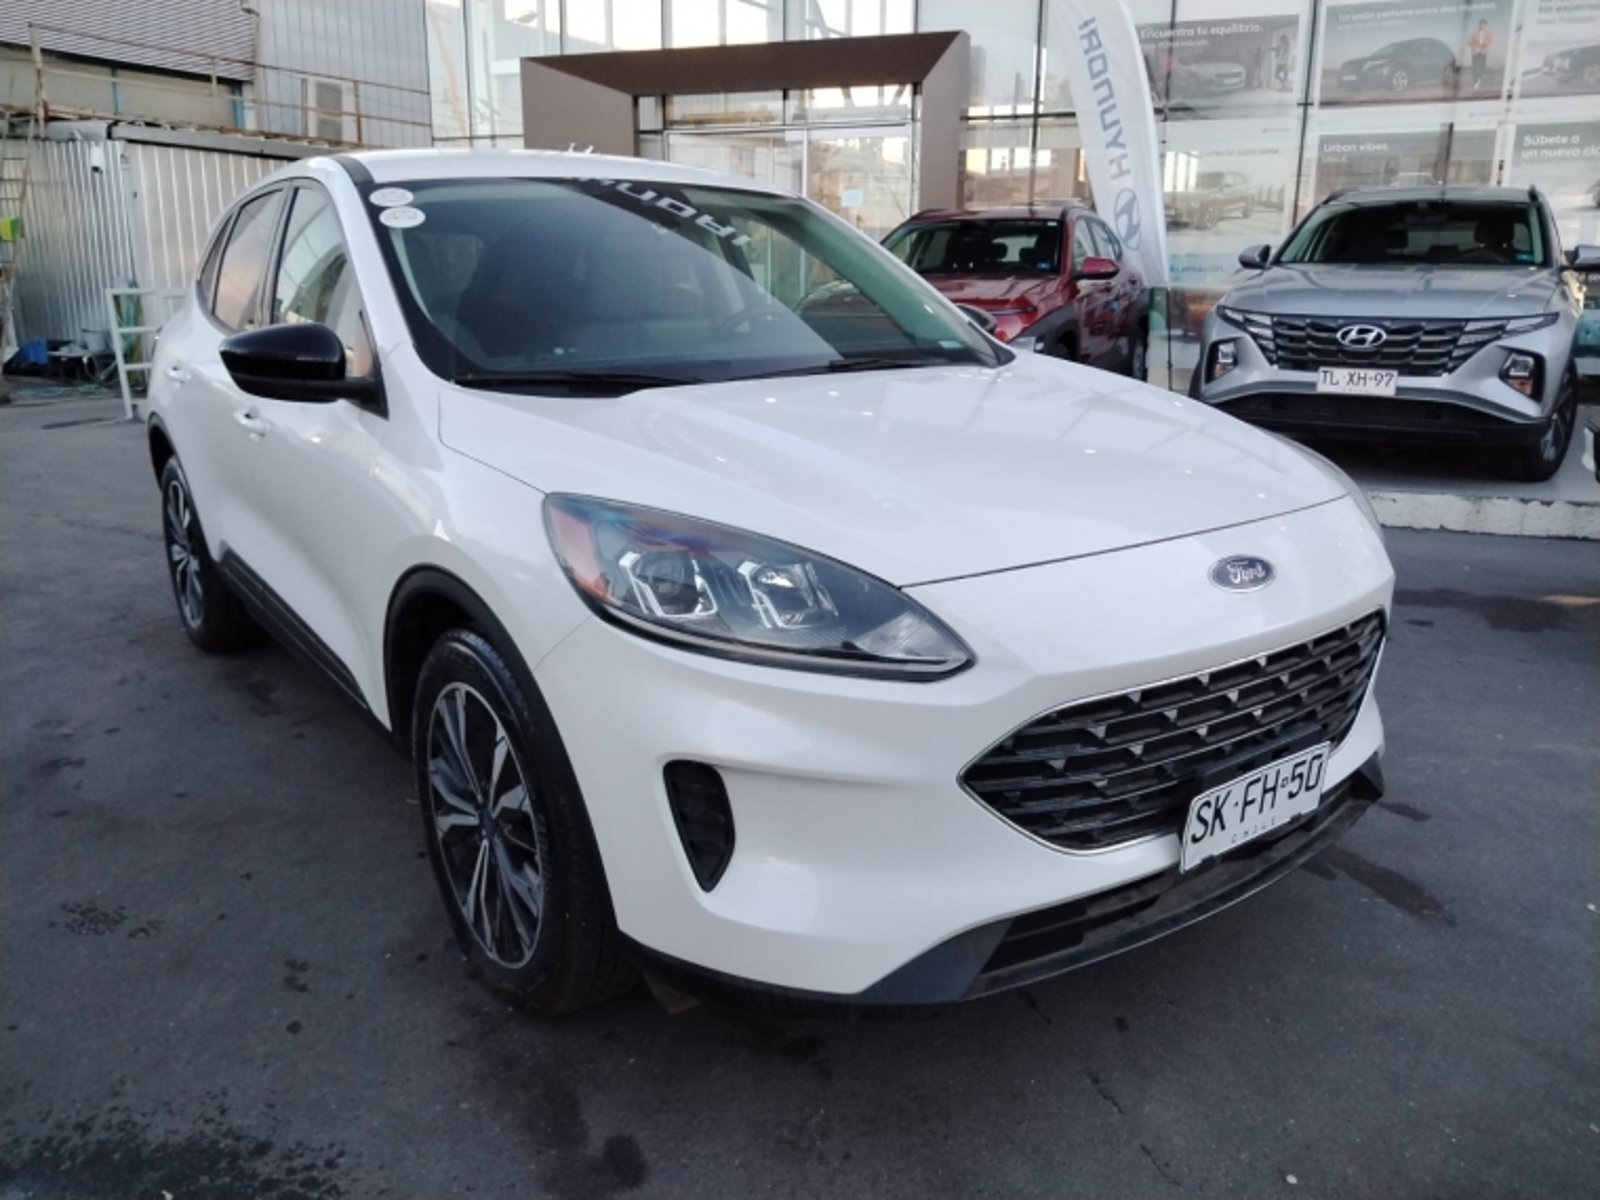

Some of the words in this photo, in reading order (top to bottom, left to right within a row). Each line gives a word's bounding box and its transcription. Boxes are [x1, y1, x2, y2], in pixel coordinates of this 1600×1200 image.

[1523, 133, 1569, 147] Súbete
[1323, 142, 1357, 153] Urban
[1521, 148, 1538, 159] un
[1540, 147, 1581, 158] nuevo
[1226, 559, 1267, 585] Ford
